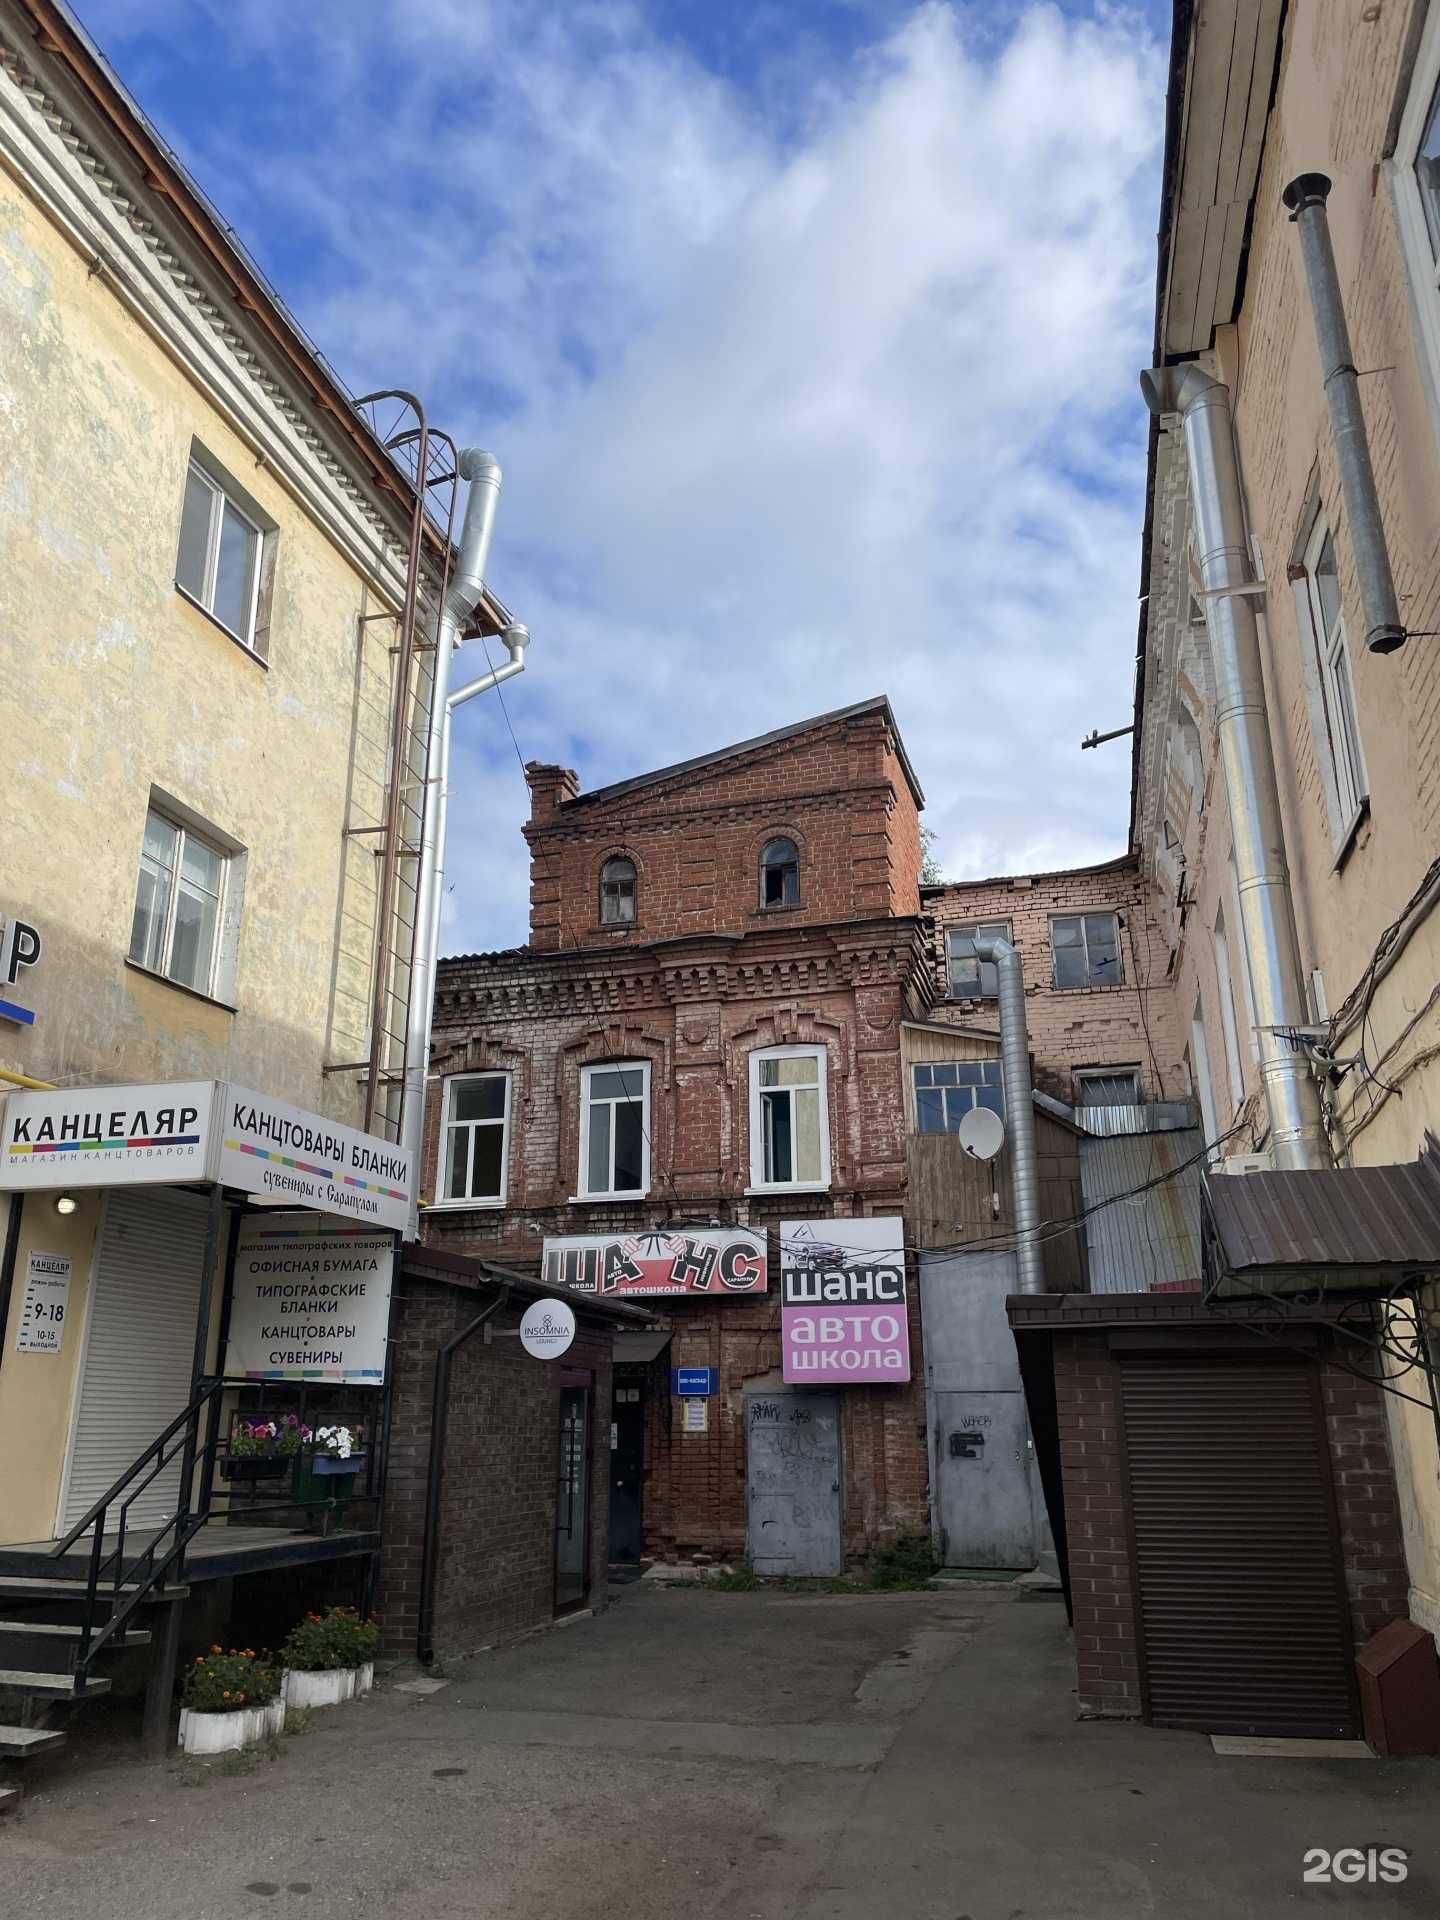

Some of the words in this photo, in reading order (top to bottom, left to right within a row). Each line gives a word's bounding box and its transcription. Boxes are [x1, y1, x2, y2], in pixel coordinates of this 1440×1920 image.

[13, 1107, 198, 1143] КАНЦЕЛЯР
[233, 1103, 345, 1162] КАНЦТОВАРЫ
[351, 1145, 407, 1183] БЛАНКИ
[10, 1153, 77, 1164] МАГАЗИН
[83, 1147, 195, 1160] КАНЦТОВАРОВ
[263, 1169, 314, 1196] сувениры
[318, 1186, 323, 1199] с
[327, 1184, 378, 1214] Сарапулом
[240, 1243, 279, 1252] магазин
[282, 1240, 351, 1252] типографских
[354, 1240, 392, 1250] товаров
[31, 1259, 70, 1272] КАНЦЕЛЯР
[250, 1260, 319, 1273] ОФИСНАЯ
[323, 1259, 378, 1272] БУМАГА
[256, 1284, 366, 1298] ТИПОГРАФСКИЕ
[619, 1285, 687, 1295] автошкола
[35, 1303, 64, 1321] 9-18
[280, 1301, 338, 1313] БЛАНКИ
[37, 1330, 55, 1340] 10-15
[261, 1325, 356, 1340] КАНЦТОВАРЫ
[525, 1327, 569, 1335] INSOMNIA
[790, 1315, 899, 1343] авто
[269, 1352, 342, 1364] СУВЕНИРЫ
[792, 1348, 902, 1369] школа
